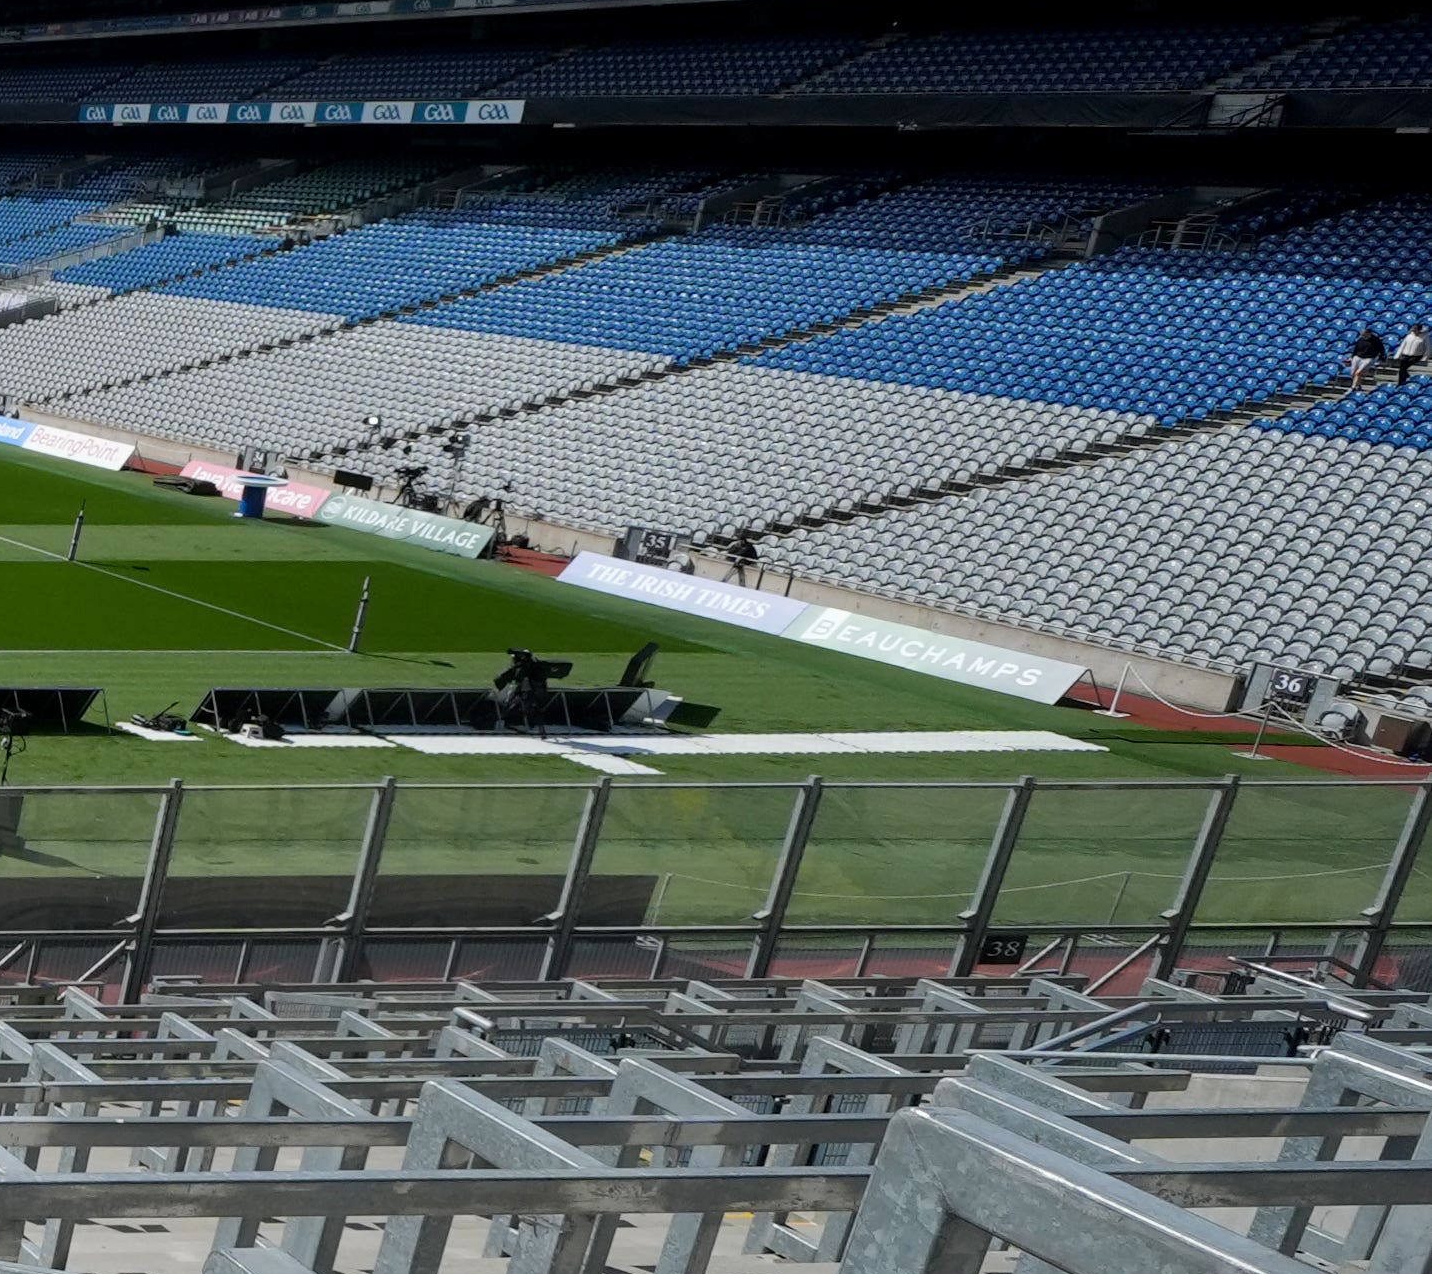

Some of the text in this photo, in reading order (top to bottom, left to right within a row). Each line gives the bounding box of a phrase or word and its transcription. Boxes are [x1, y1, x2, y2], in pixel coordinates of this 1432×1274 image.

[325, 105, 352, 120] GAA
[424, 104, 455, 120] GAA
[478, 103, 509, 120] GAA
[30, 427, 120, 461] BearingPoint
[341, 505, 481, 550] KILDARE VILLAGE
[645, 534, 667, 549] 35
[586, 563, 770, 620] THE IRISH TIMES
[807, 619, 1043, 687] BEAUCHAMPS
[1274, 673, 1304, 693] 36
[986, 940, 1020, 958] 38
